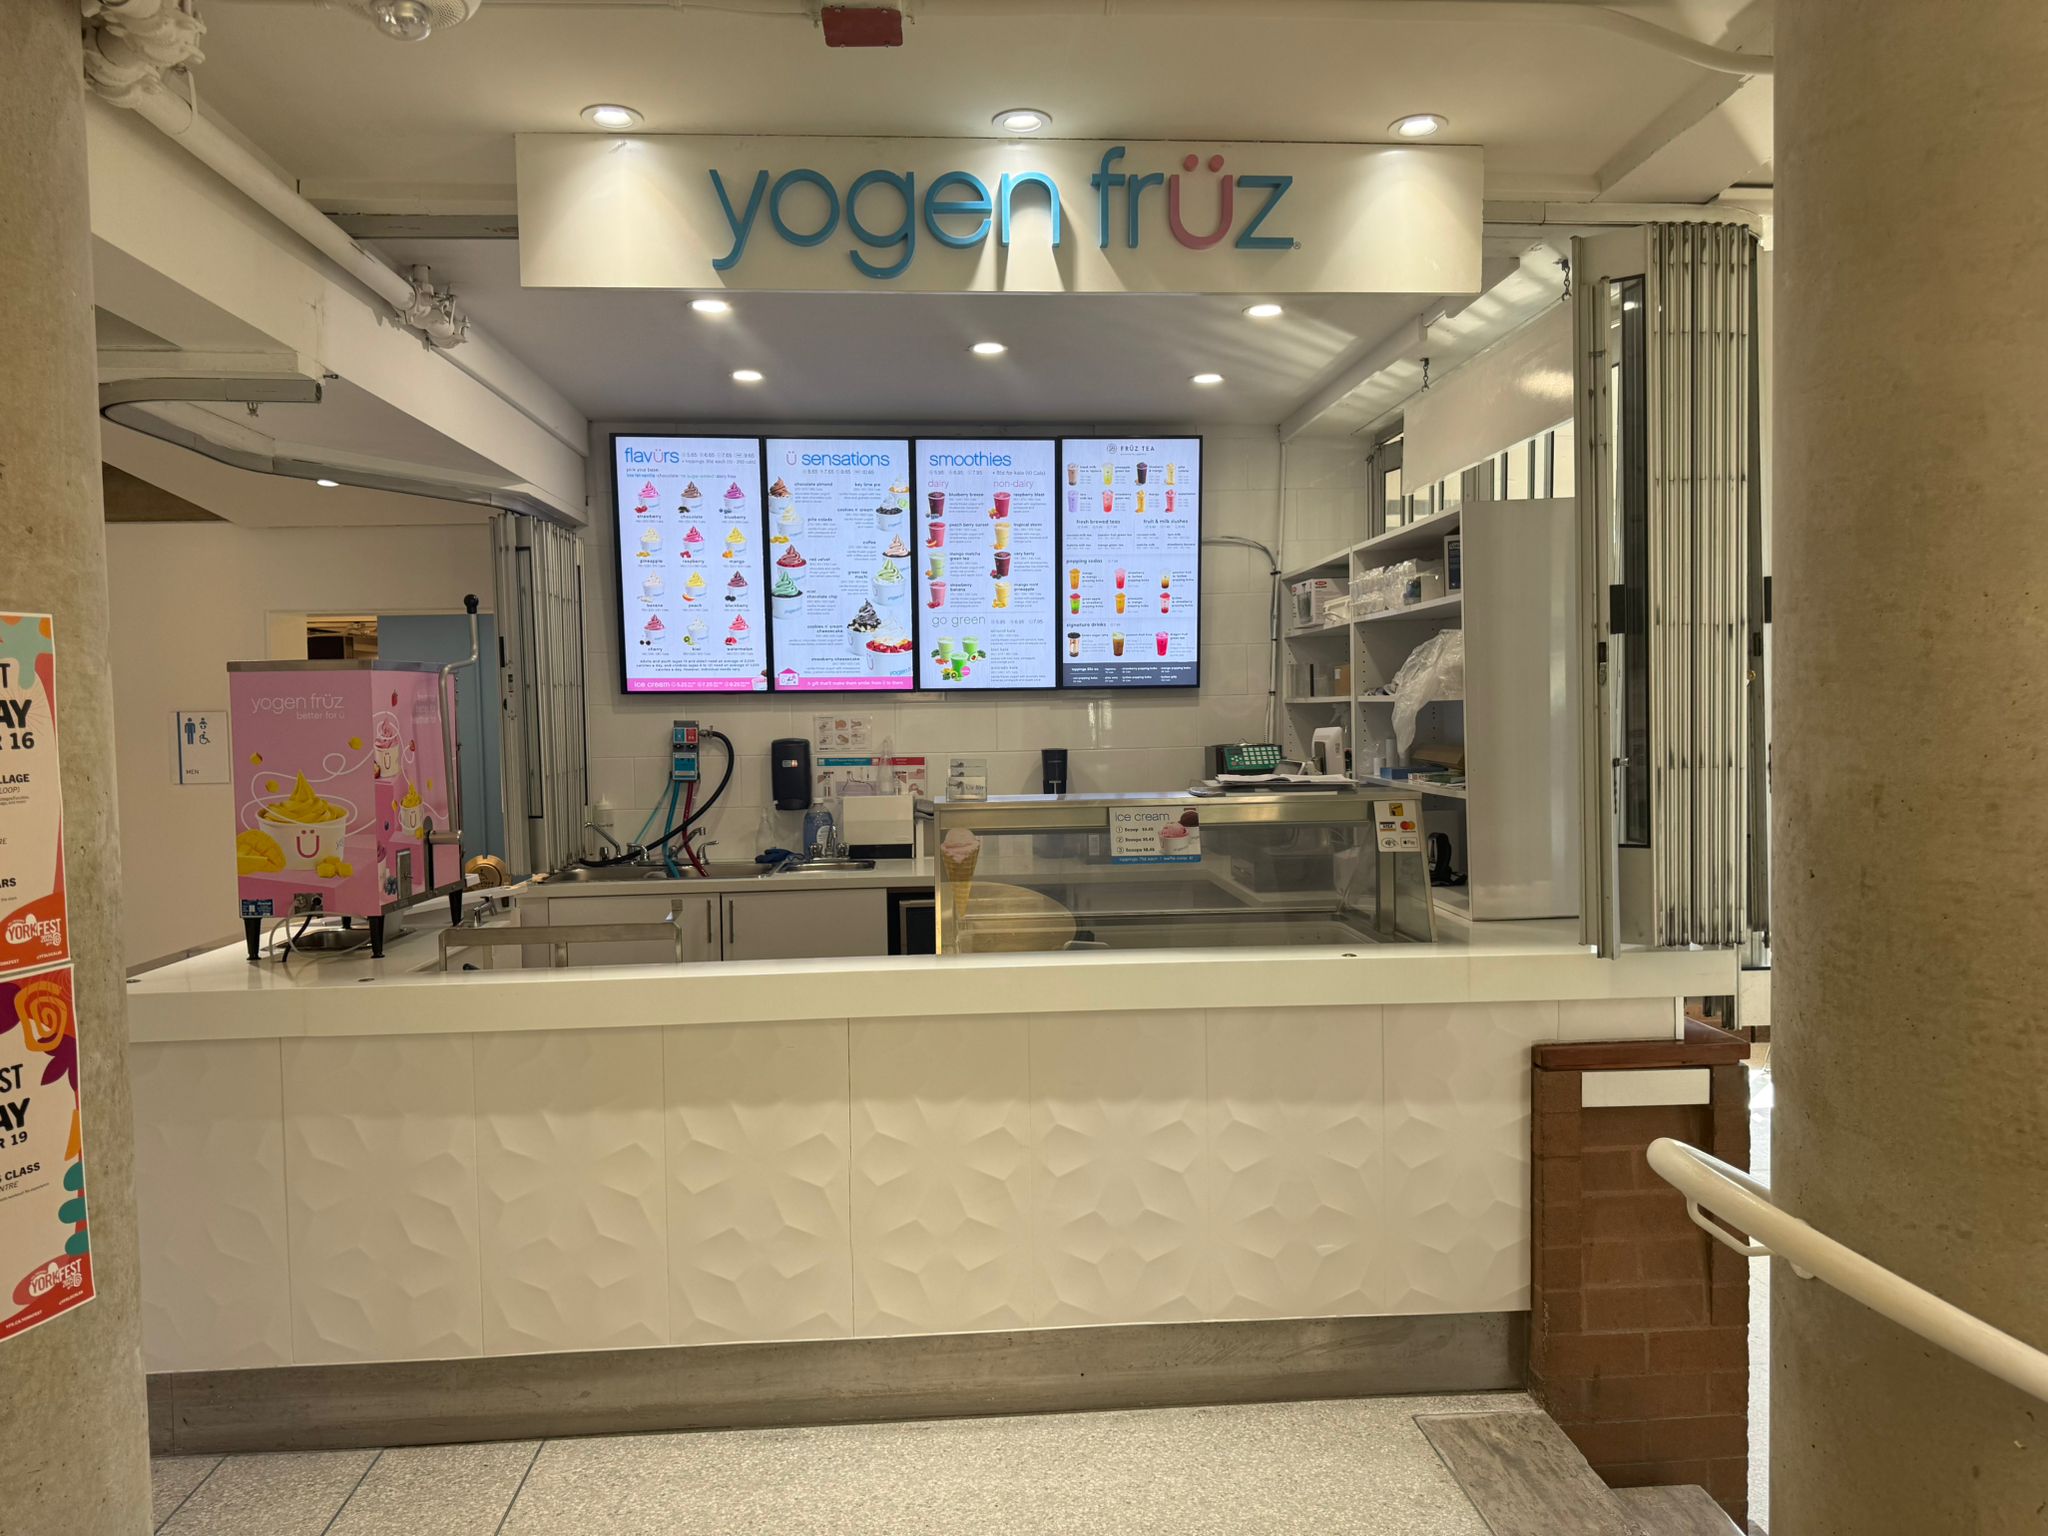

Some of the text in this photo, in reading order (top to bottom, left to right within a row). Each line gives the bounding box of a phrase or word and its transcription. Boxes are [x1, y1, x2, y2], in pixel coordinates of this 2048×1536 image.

[708, 146, 1295, 279] yogen früz
[624, 447, 680, 463] flavürs
[802, 452, 890, 466] sensations
[929, 451, 1012, 466] smoothies
[928, 480, 949, 489] dairy
[993, 480, 1034, 489] non-dairy
[932, 616, 986, 628] go green
[251, 692, 345, 714] yogen früz
[325, 711, 336, 720] for
[10, 732, 35, 750] 16
[1134, 812, 1171, 822] cream
[11, 1131, 28, 1146] 19
[4, 1162, 41, 1181] CLASS
